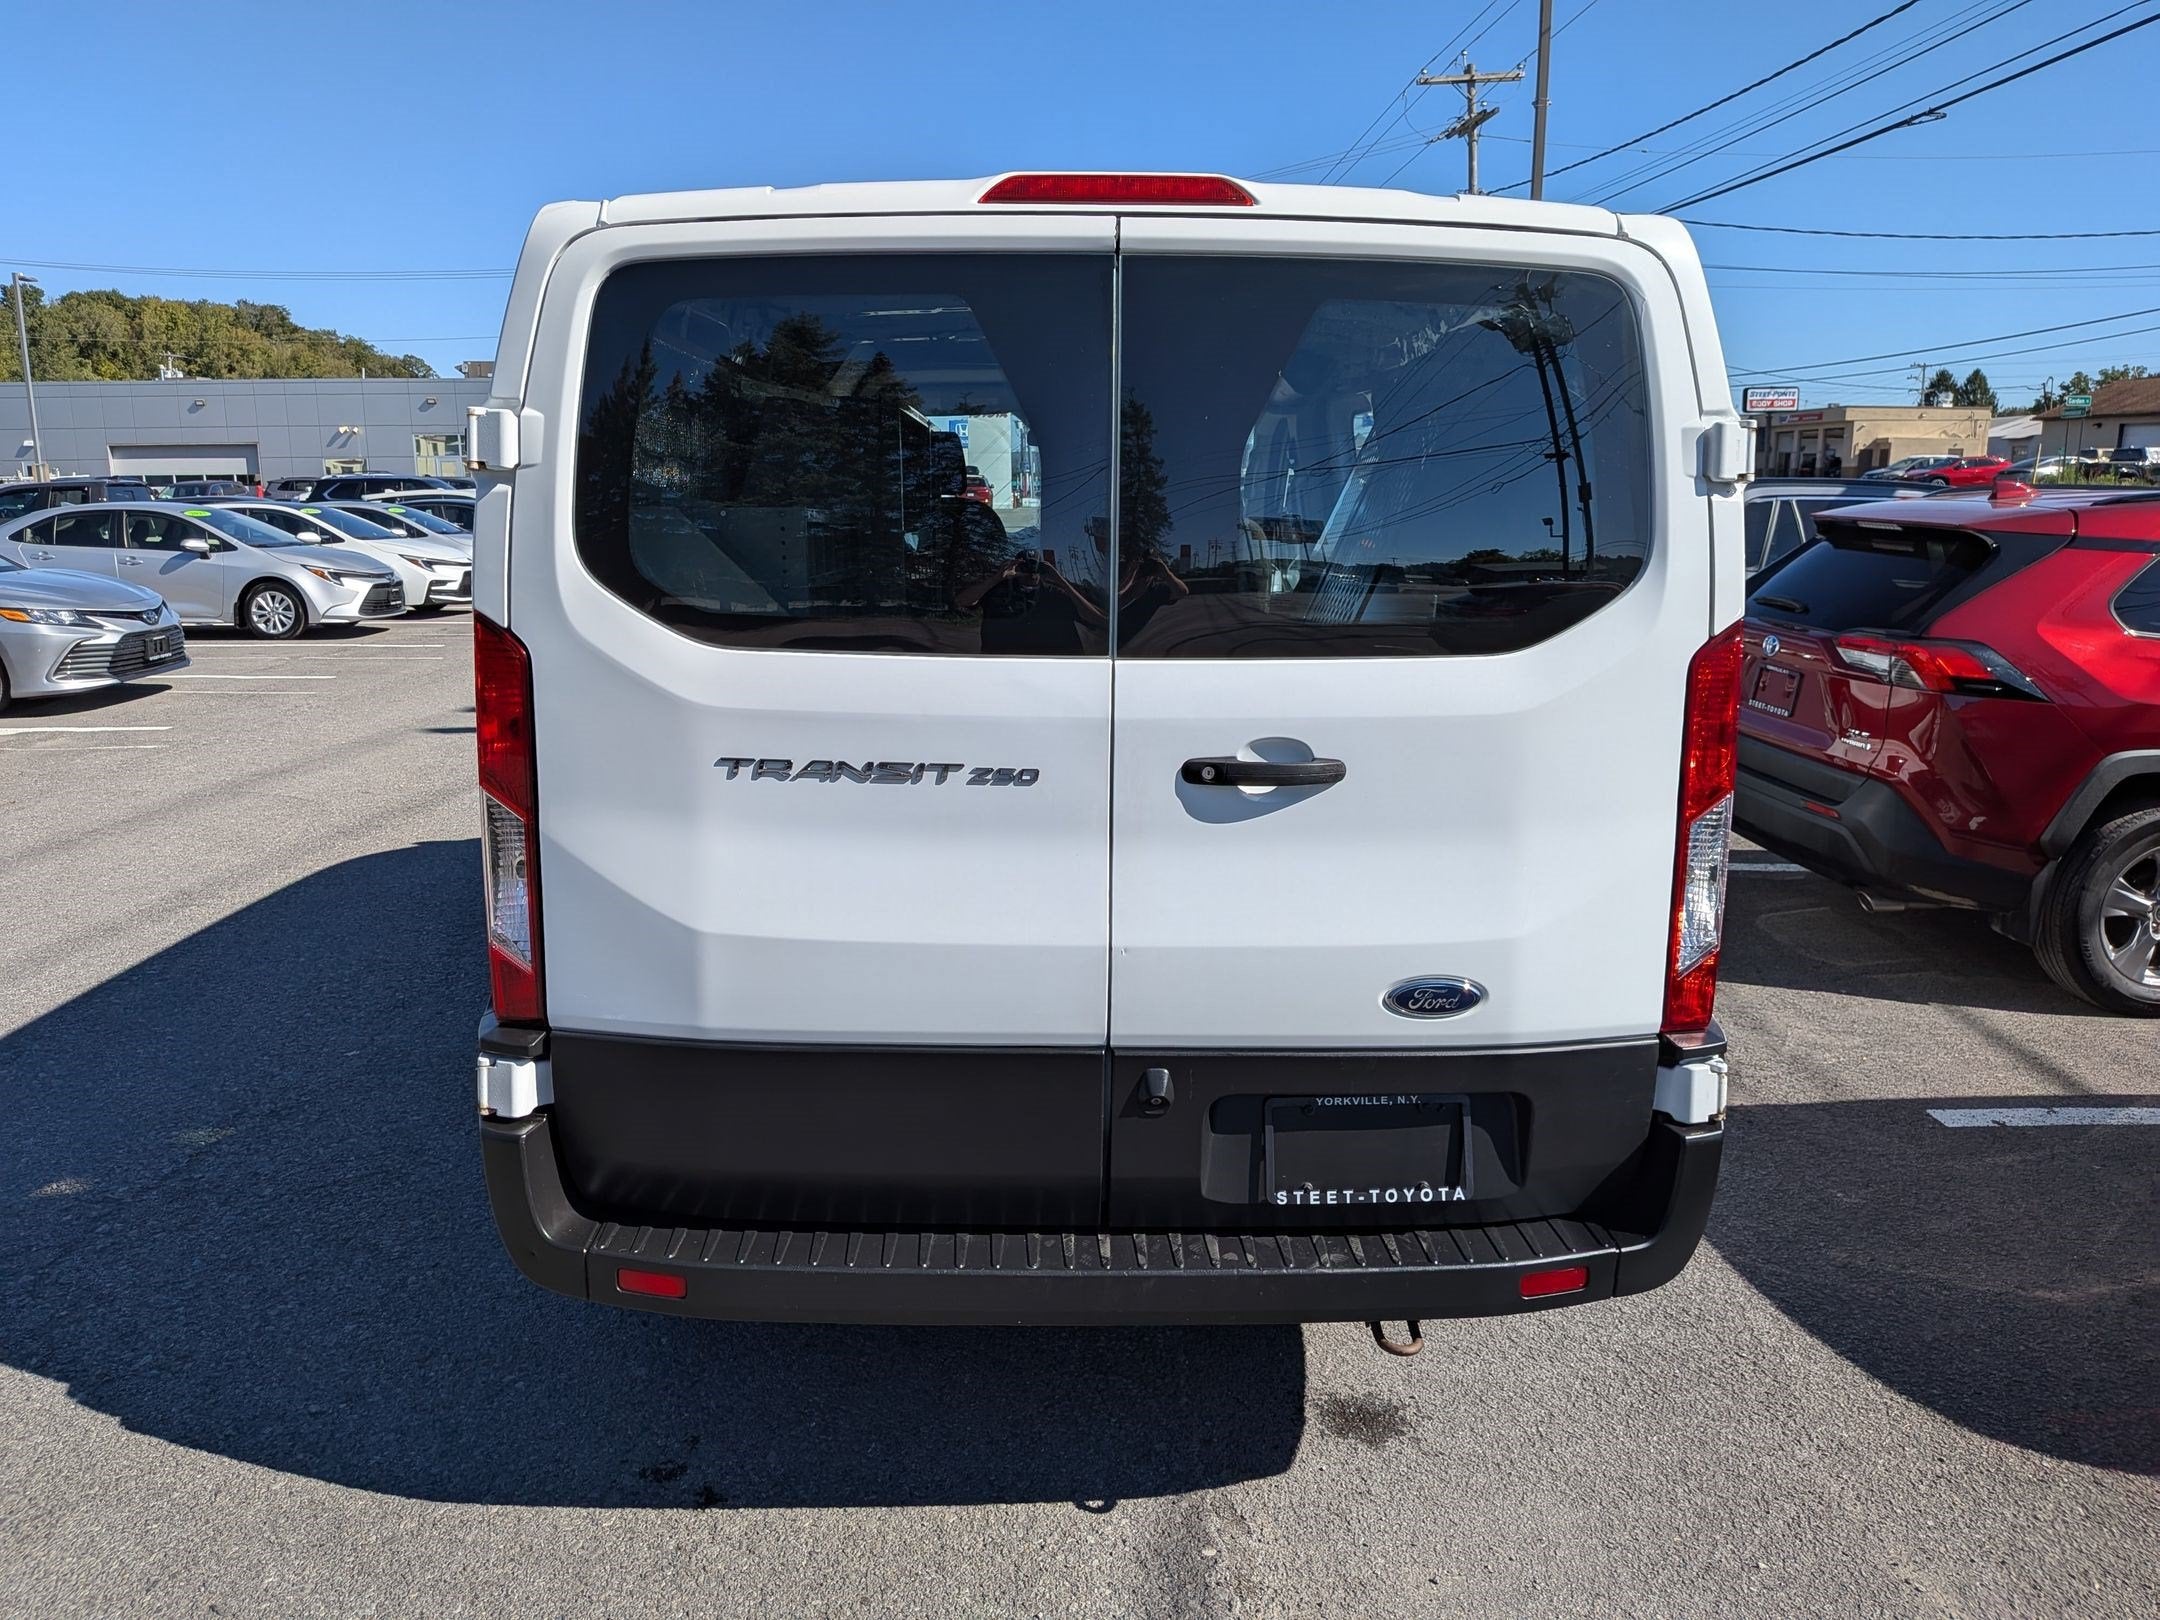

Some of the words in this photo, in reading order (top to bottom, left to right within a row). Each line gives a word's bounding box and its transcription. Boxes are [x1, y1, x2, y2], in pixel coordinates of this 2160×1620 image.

[1748, 699, 1789, 717] STEET-TOYOTA
[713, 757, 965, 786] TRANSIT
[965, 767, 1040, 787] 250
[1408, 988, 1461, 1010] Ford
[1315, 1095, 1394, 1107] YORKVILLE,
[1397, 1094, 1422, 1105] N.Y.
[1275, 1186, 1466, 1205] STEET-TOYOTA
